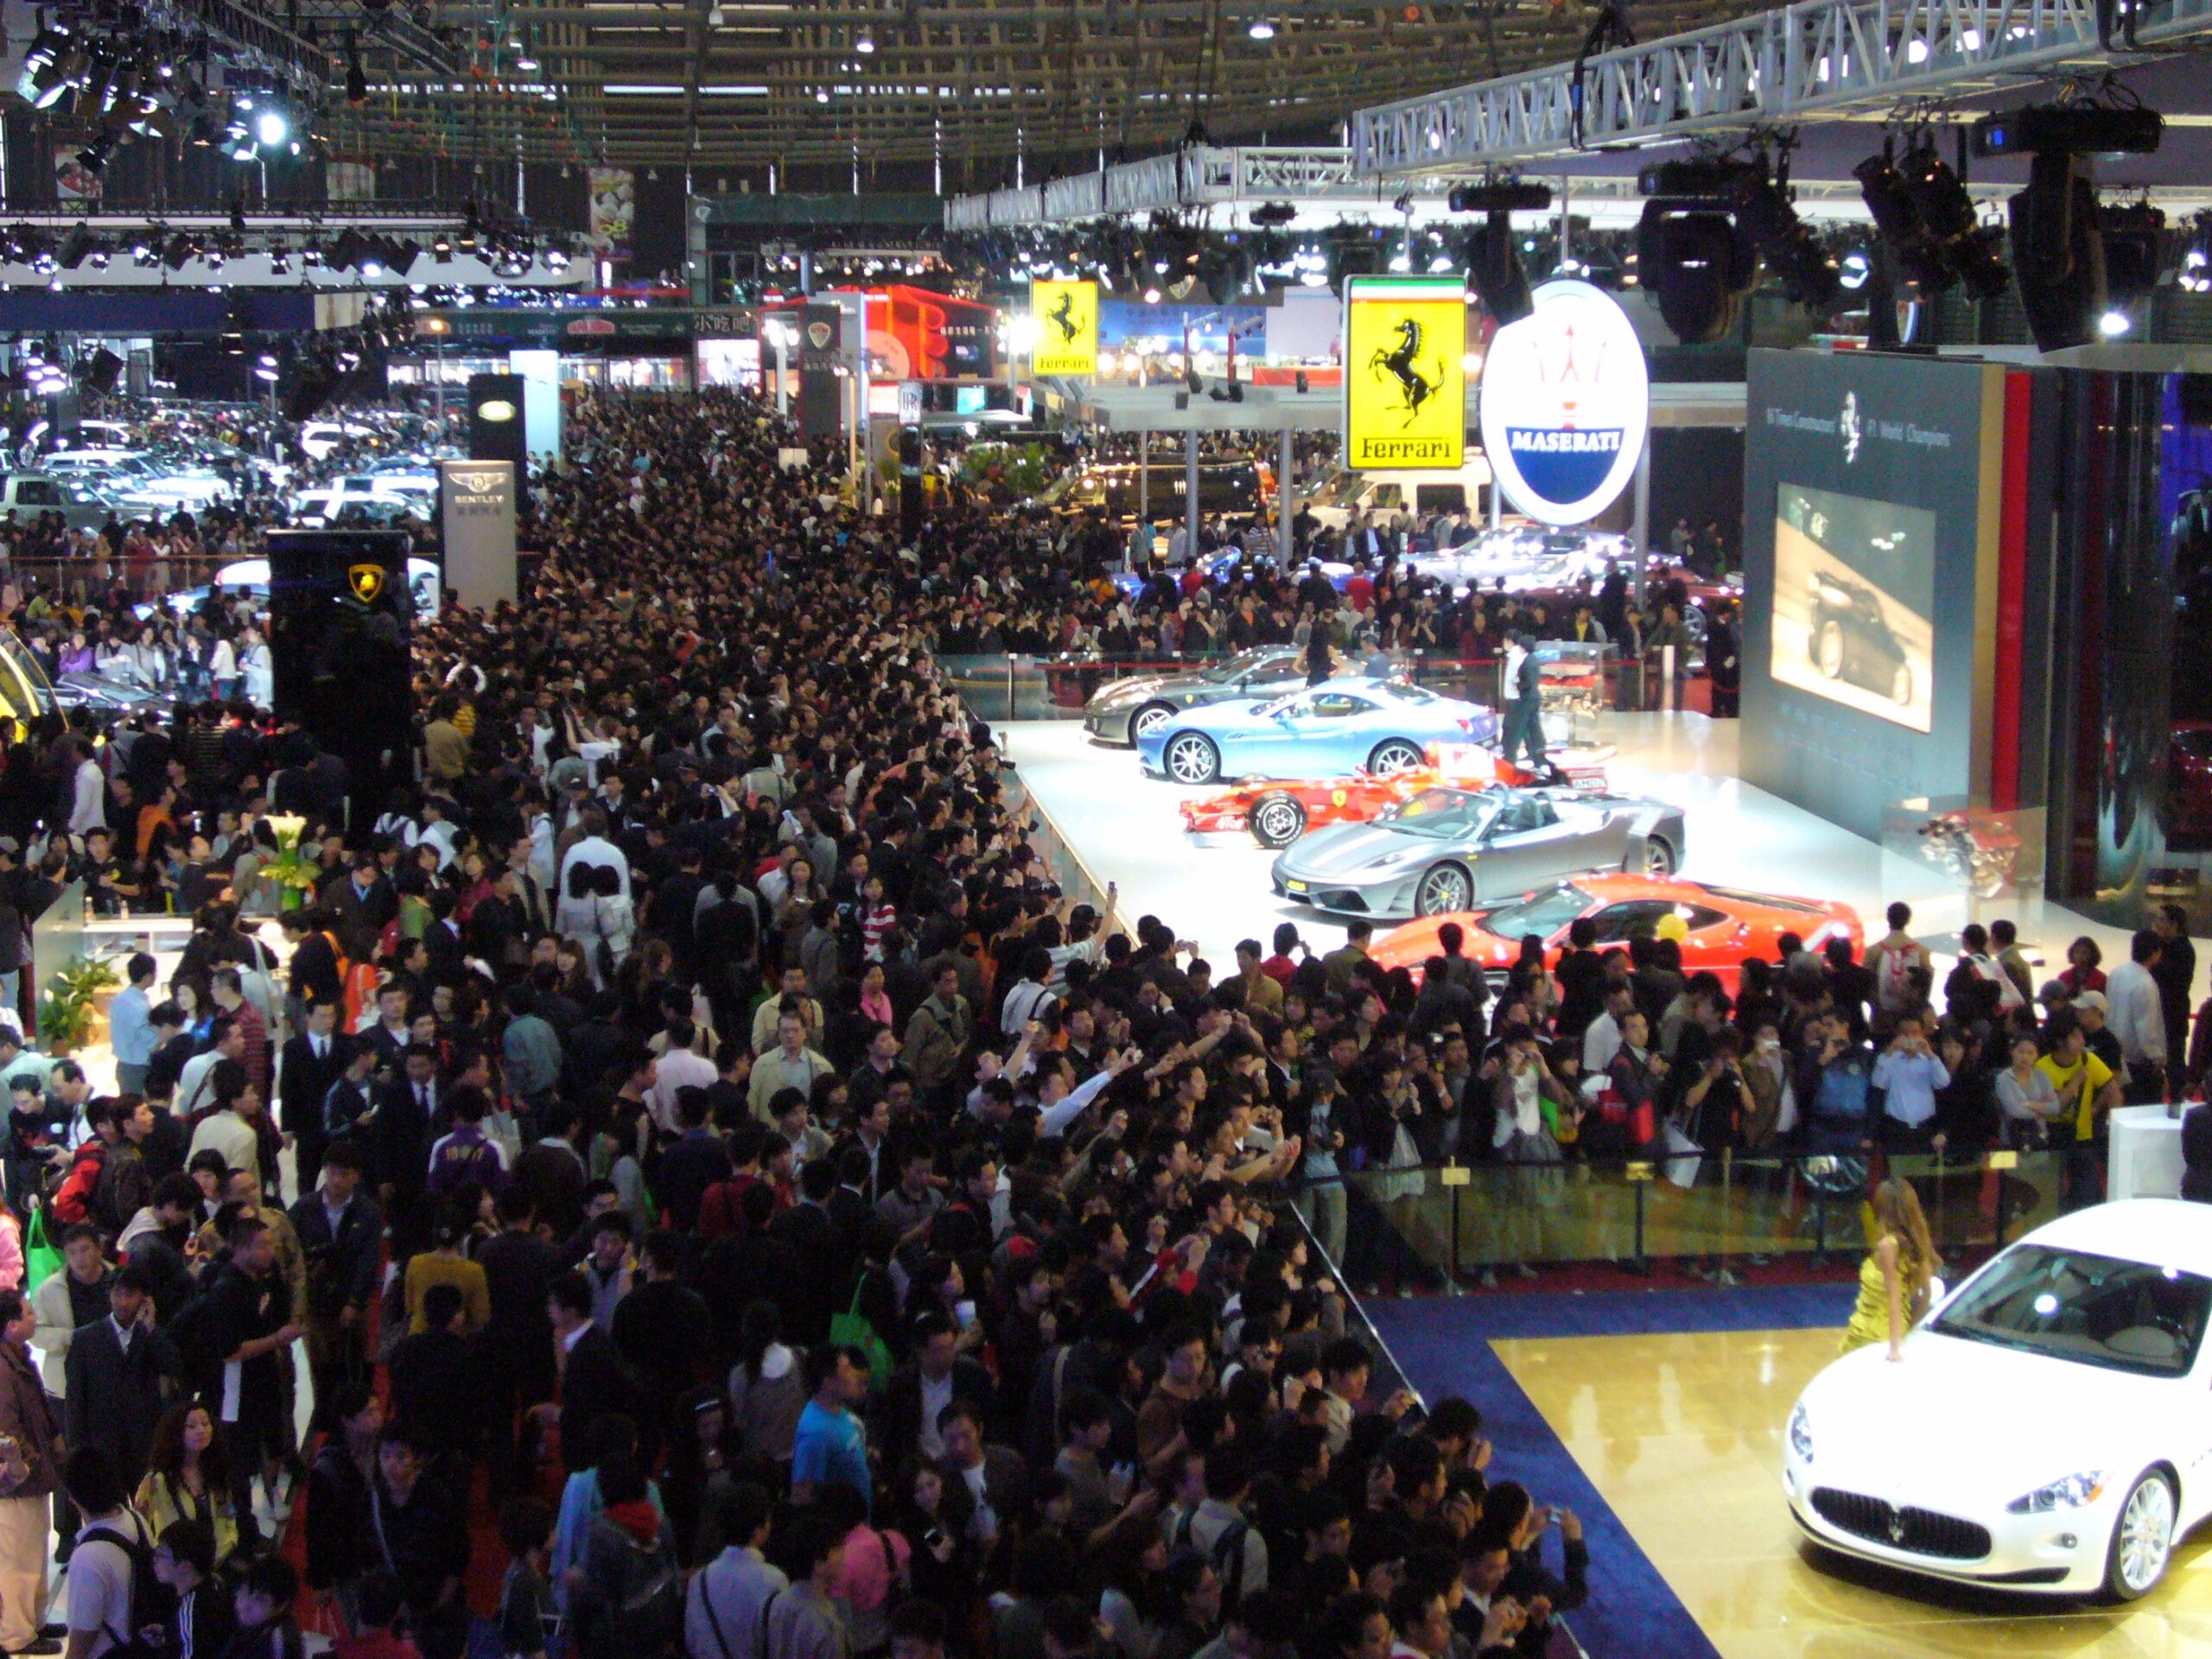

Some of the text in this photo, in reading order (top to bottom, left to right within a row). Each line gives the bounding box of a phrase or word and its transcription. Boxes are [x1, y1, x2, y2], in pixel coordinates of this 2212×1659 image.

[694, 315, 750, 333] 小吃吧
[1360, 437, 1451, 459] Ferrari
[1510, 430, 1621, 451] MASERATI
[454, 494, 505, 505] BENTLEY
